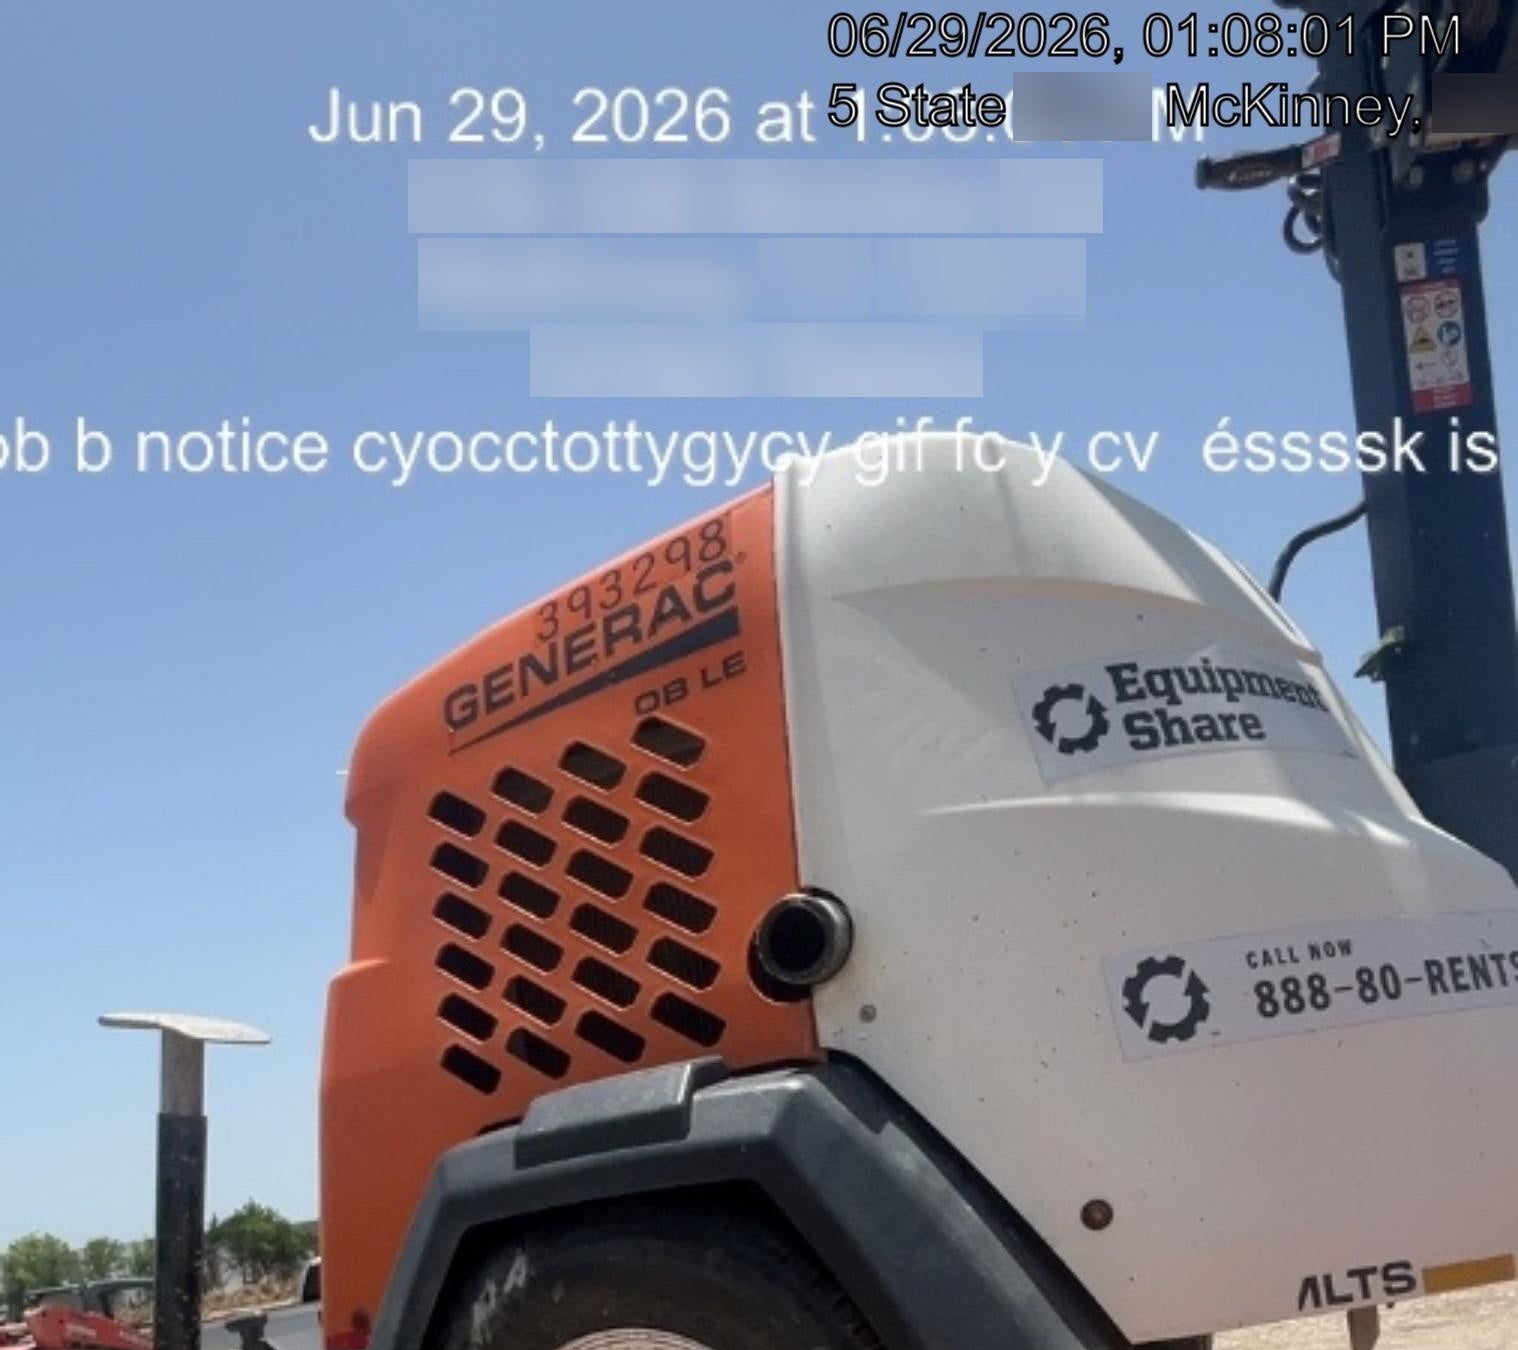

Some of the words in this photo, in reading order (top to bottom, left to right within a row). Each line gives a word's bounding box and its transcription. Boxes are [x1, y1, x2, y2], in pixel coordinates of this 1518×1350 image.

[534, 517, 729, 644] 393298
[443, 559, 737, 734] GENERAC
[1104, 656, 1330, 712] Equipment
[1122, 707, 1267, 751] Share
[1245, 946, 1300, 970] CALL
[1307, 938, 1352, 961] NOW
